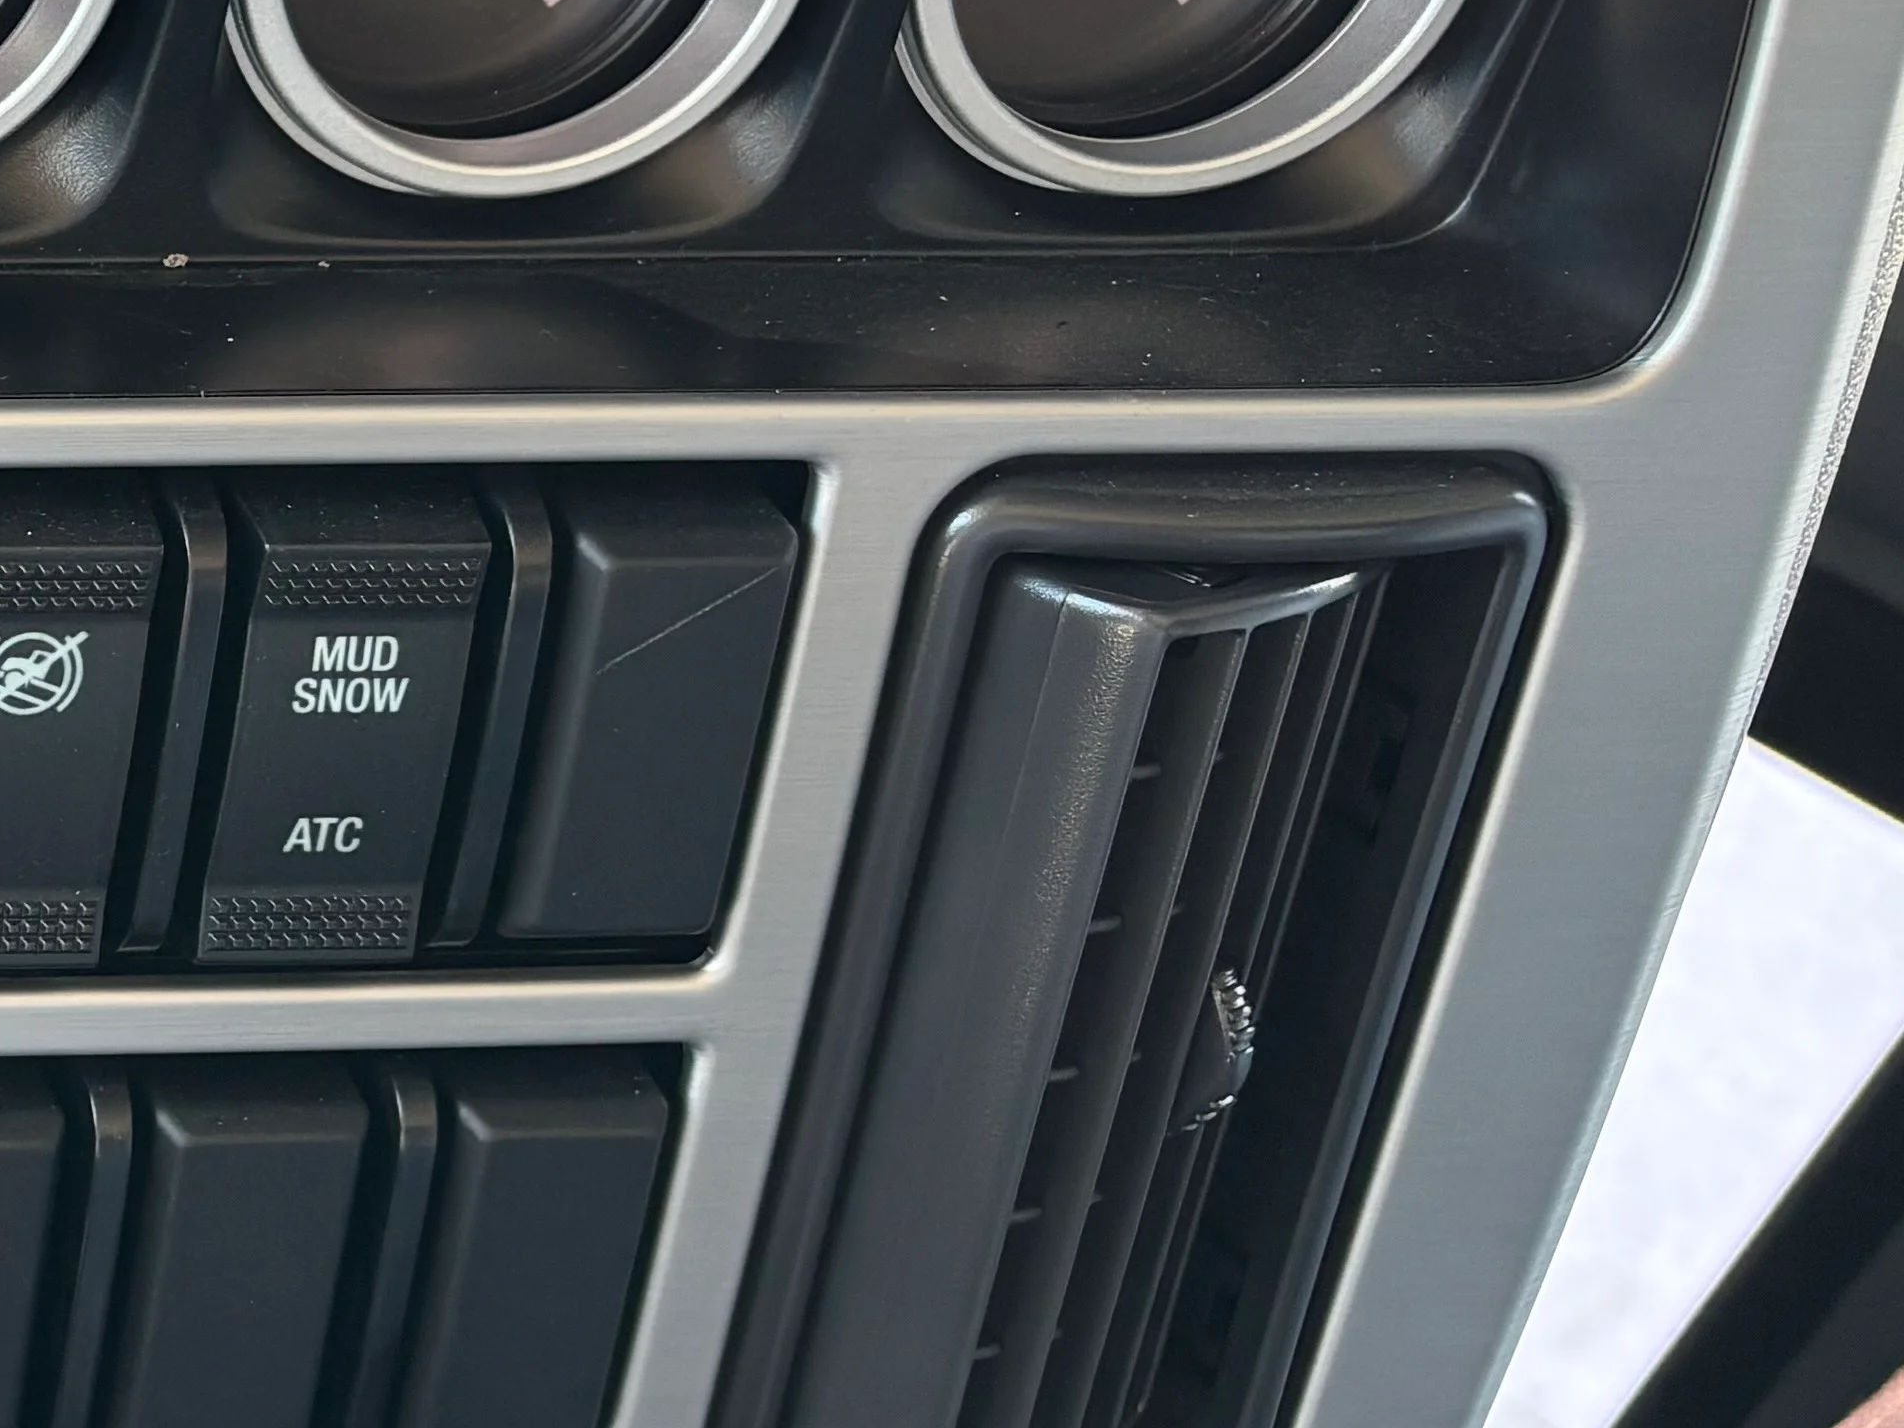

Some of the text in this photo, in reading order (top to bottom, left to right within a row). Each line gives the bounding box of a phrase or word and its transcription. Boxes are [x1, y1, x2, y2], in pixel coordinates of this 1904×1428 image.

[311, 635, 399, 672] MUD
[292, 677, 410, 714] SNOW
[282, 816, 363, 853] ATC
